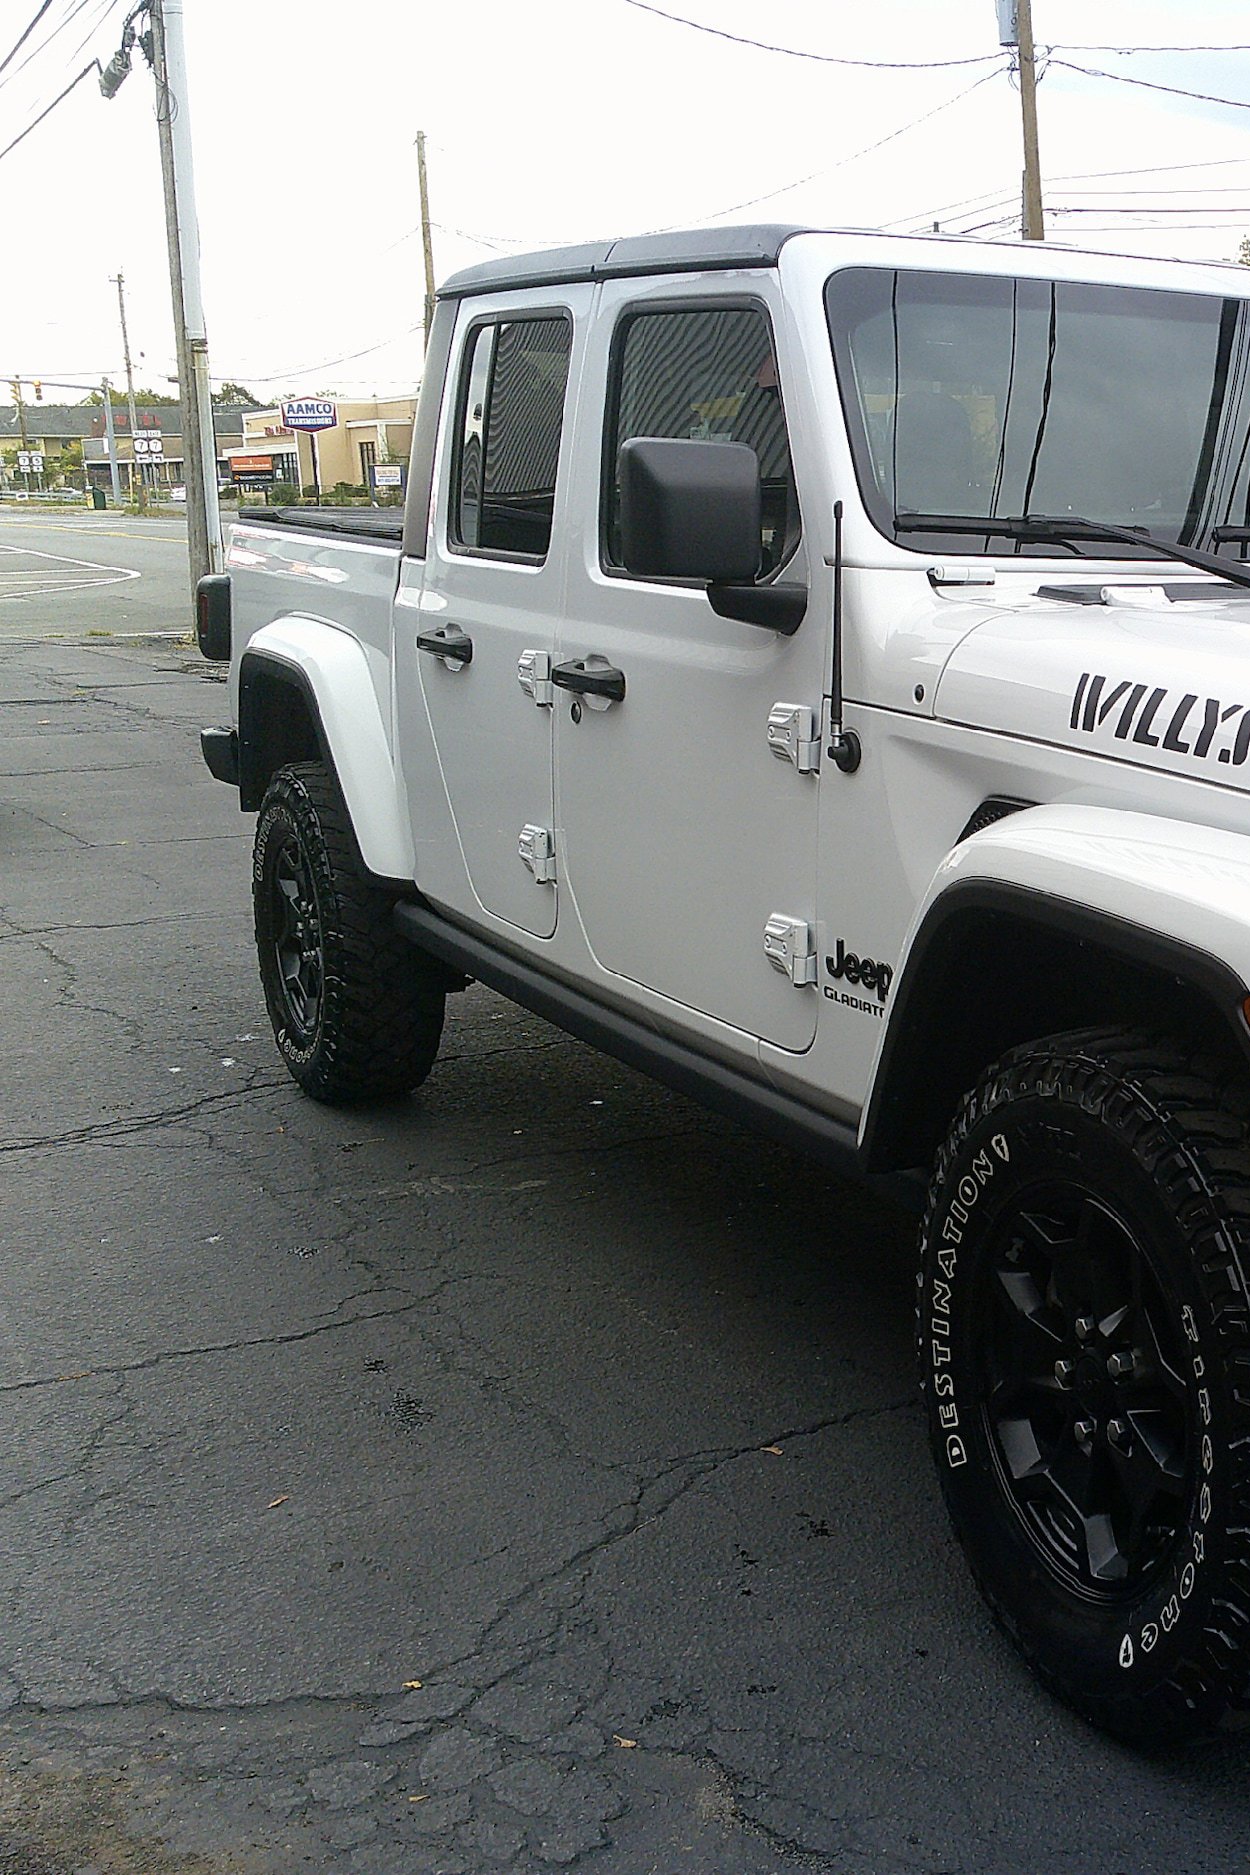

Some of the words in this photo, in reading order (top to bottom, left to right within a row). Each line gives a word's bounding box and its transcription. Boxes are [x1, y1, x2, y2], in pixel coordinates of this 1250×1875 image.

[287, 403, 332, 414] AAMCO
[825, 937, 894, 1003] Jeep
[932, 1148, 995, 1467] DESTINATION
